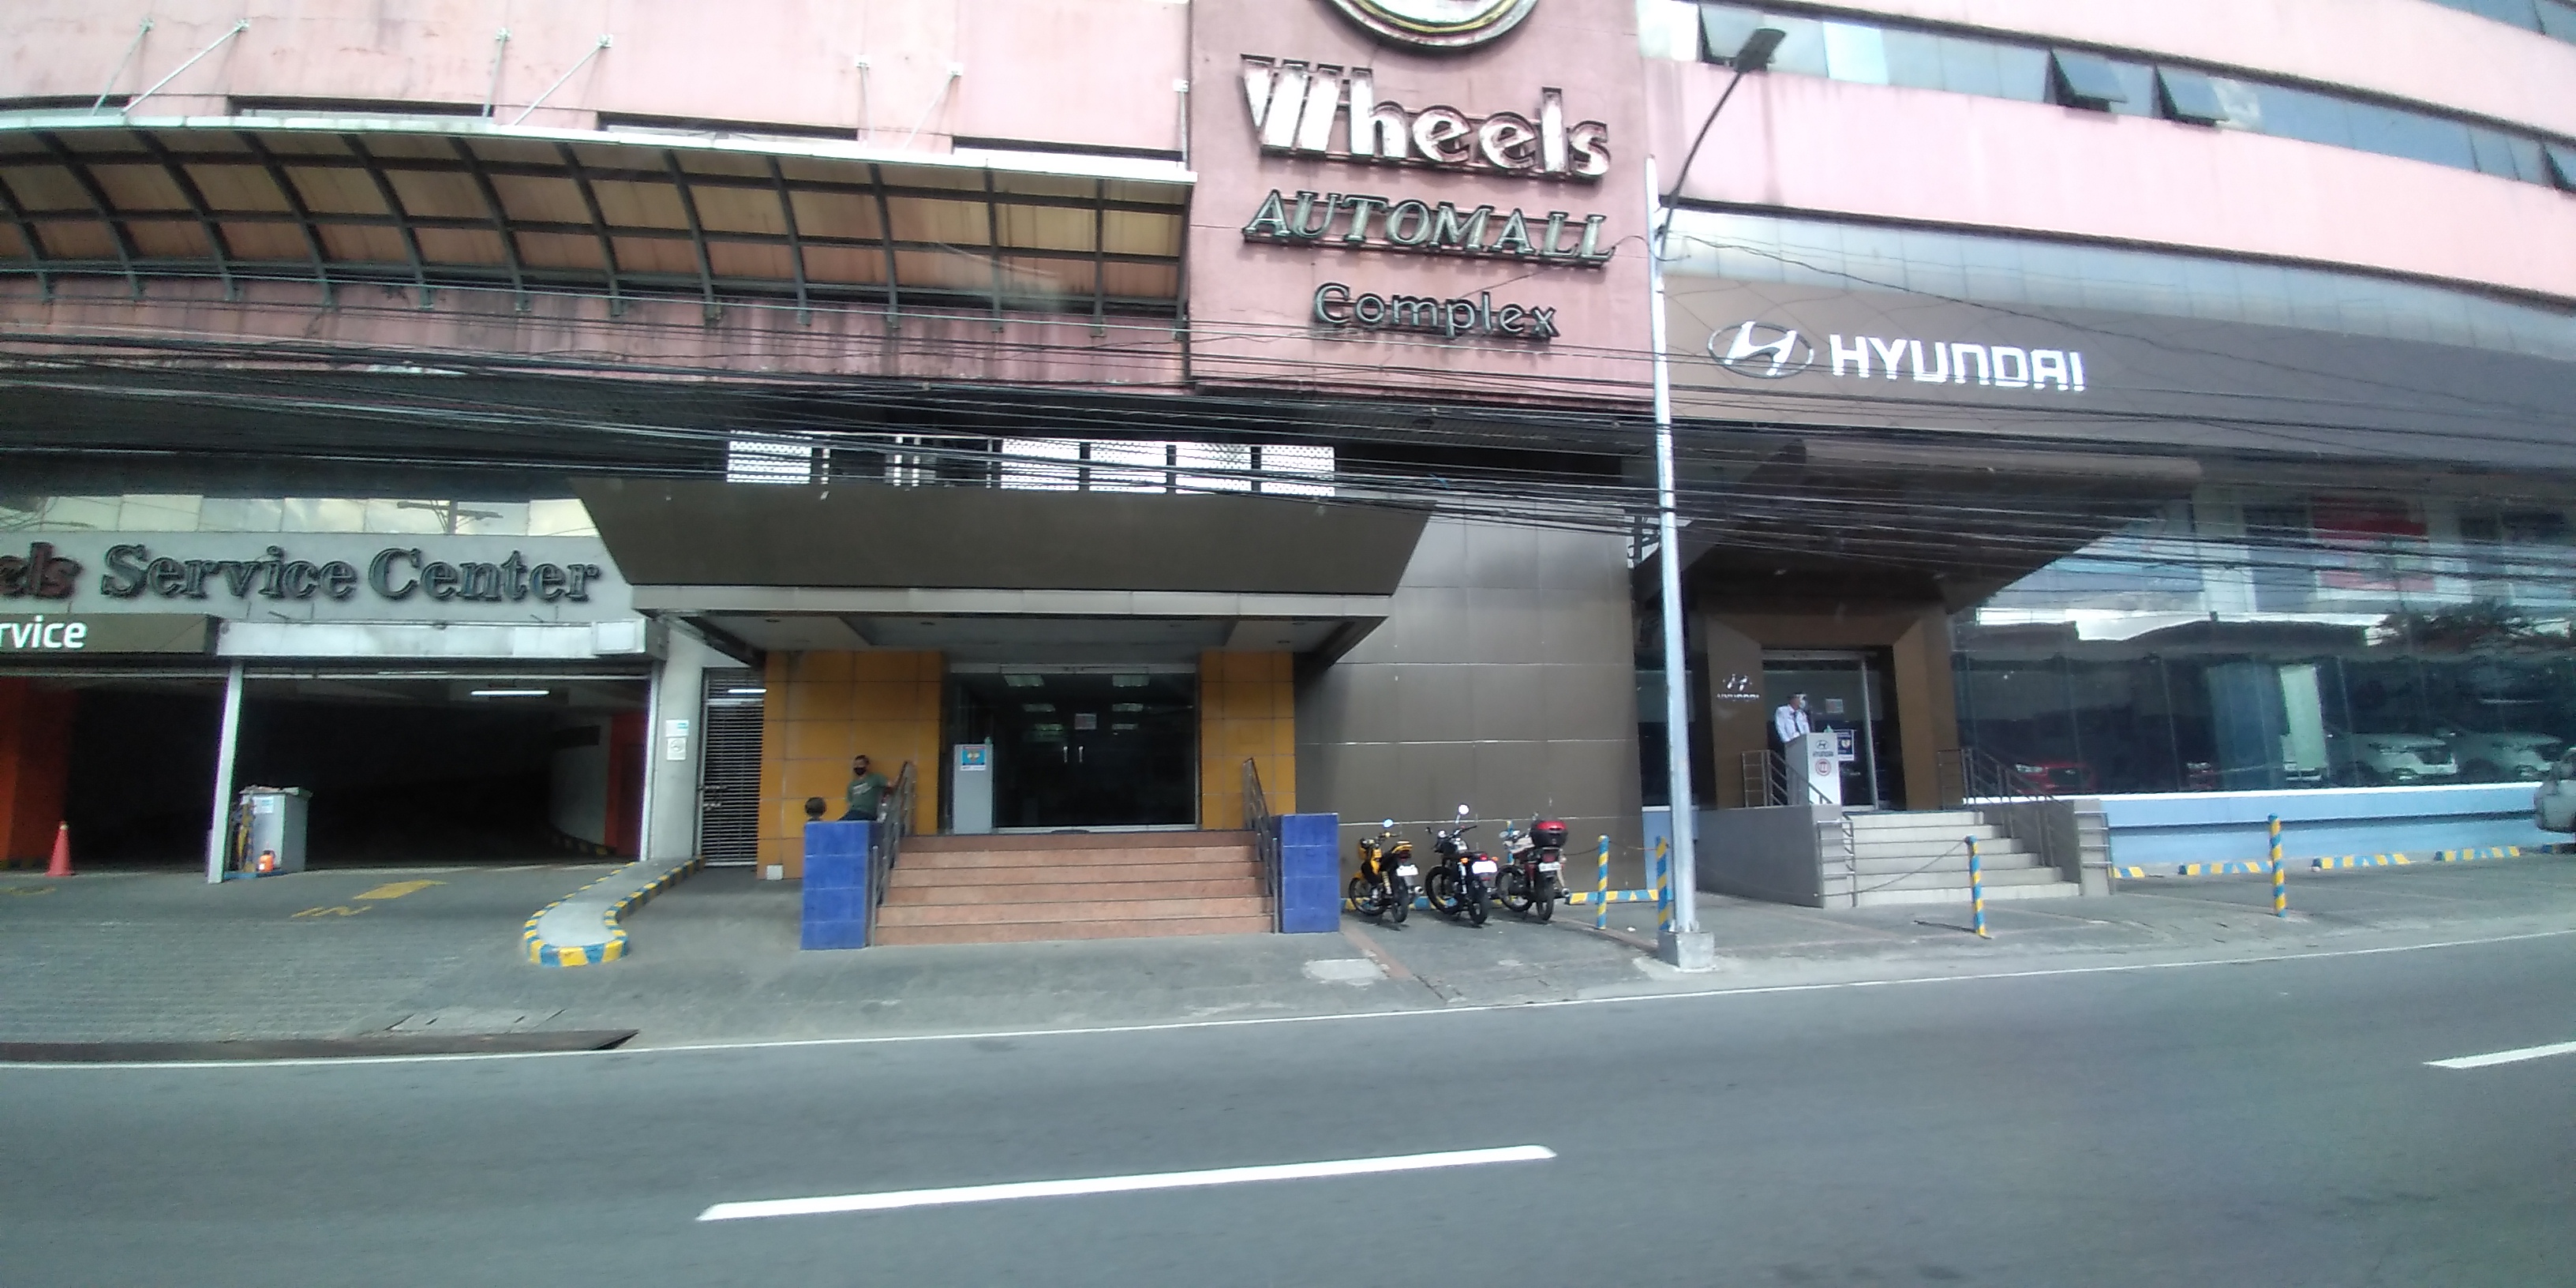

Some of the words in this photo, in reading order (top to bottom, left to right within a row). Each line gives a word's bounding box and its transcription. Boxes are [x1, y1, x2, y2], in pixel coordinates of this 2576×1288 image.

[1241, 54, 1610, 176] Wheels
[1242, 189, 1616, 265] AUTOMALL
[1313, 282, 1560, 339] Complex
[1829, 333, 2085, 391] HYUNDAI
[101, 544, 356, 599] Service
[368, 547, 601, 602] Center
